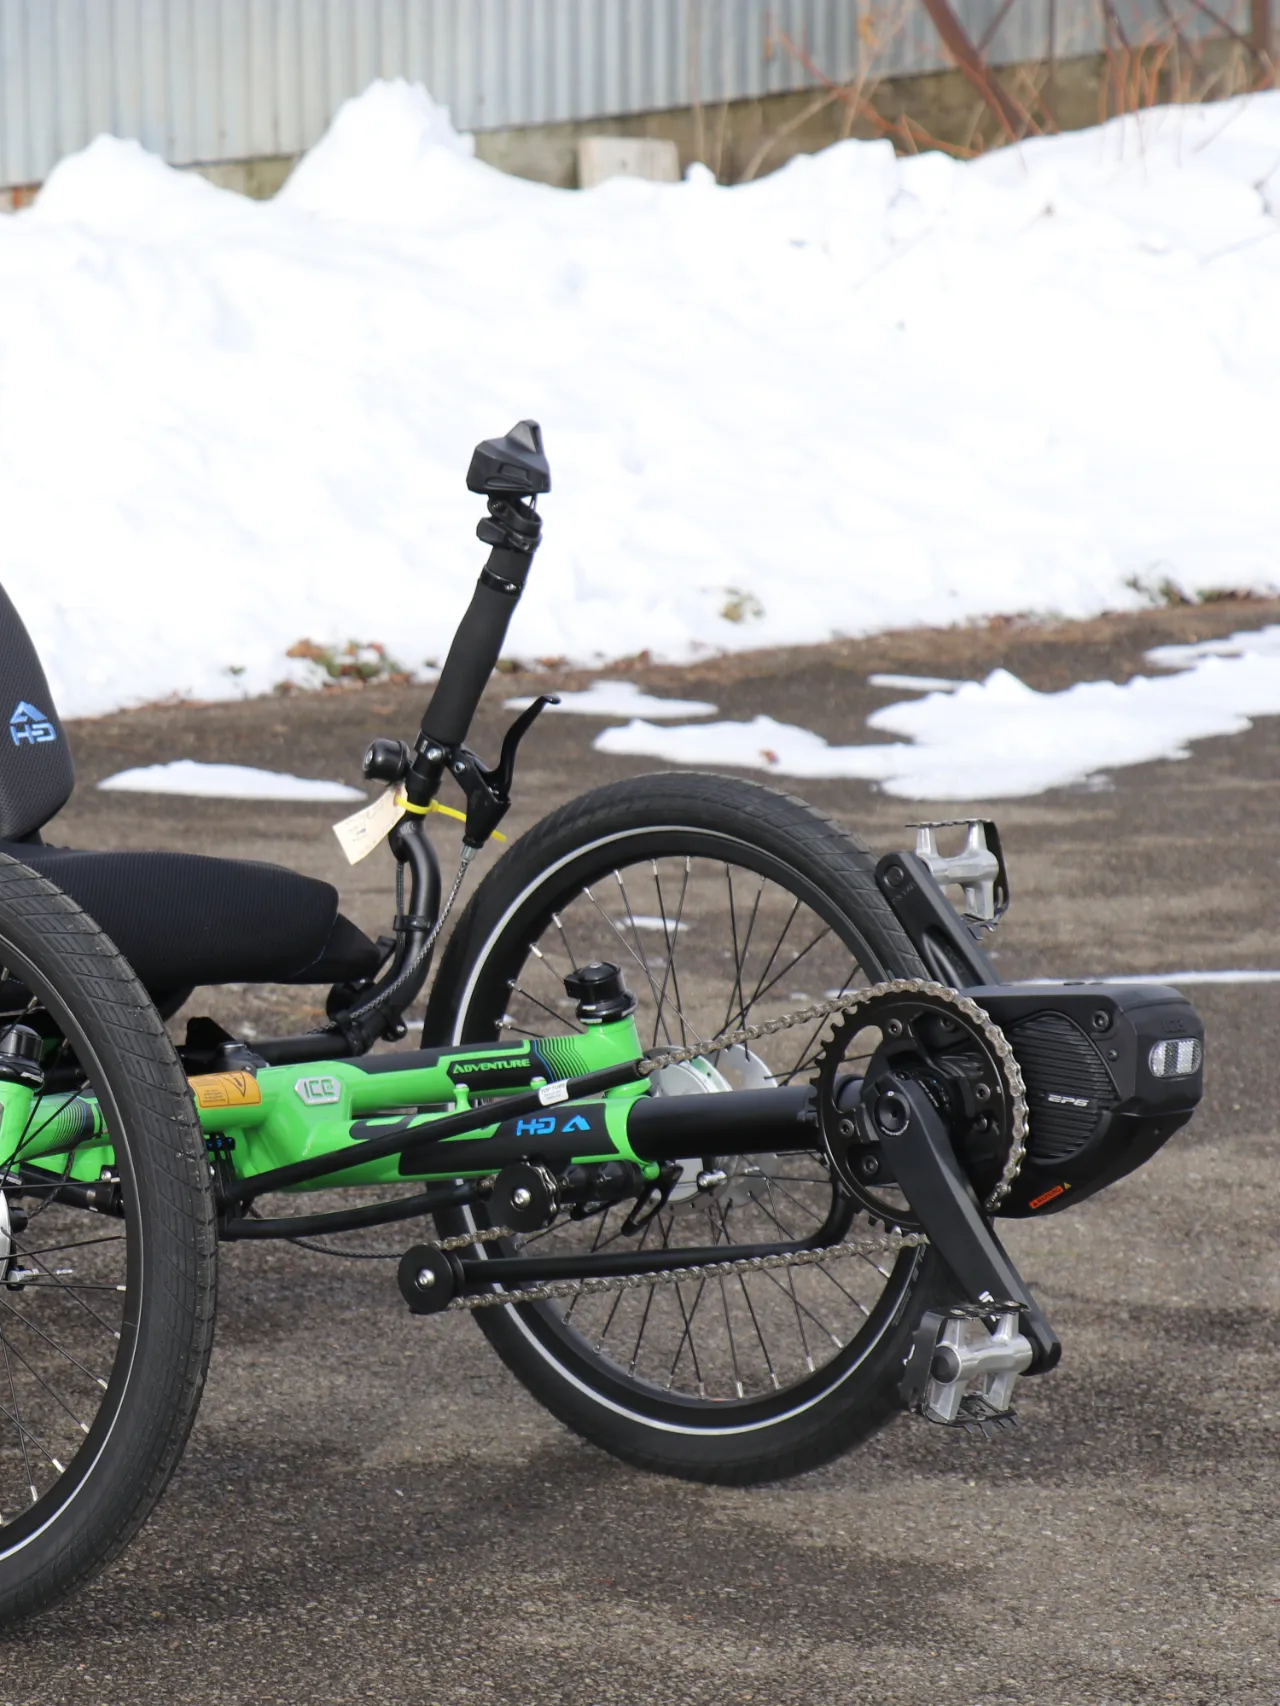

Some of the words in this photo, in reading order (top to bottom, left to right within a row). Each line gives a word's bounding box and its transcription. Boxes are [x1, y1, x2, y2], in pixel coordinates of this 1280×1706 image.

[452, 1058, 531, 1074] ADVENTURE
[304, 1079, 336, 1099] ICE
[1047, 1094, 1089, 1107] EP6
